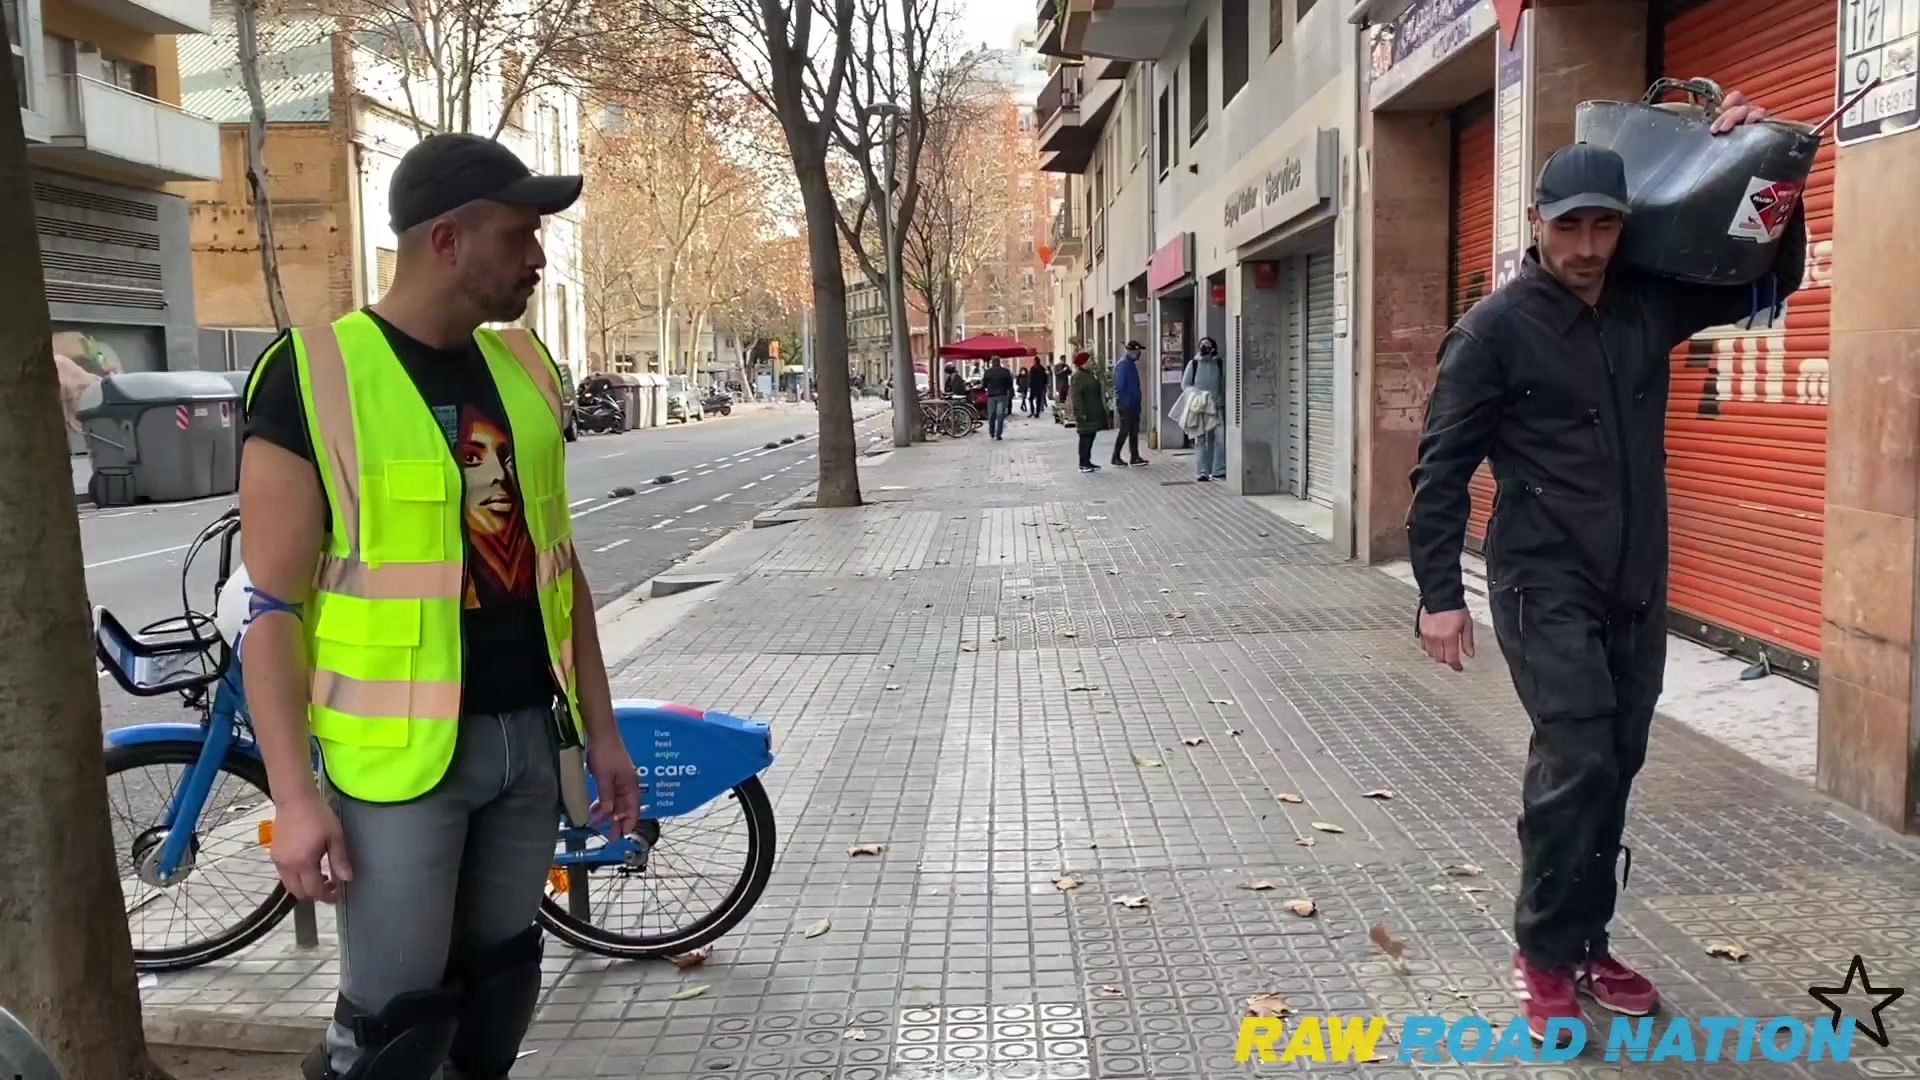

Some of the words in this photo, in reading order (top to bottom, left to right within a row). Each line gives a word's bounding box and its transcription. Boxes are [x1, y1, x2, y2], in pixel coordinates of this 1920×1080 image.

[1265, 157, 1301, 206] Service
[654, 729, 670, 737] live
[655, 740, 672, 748] feel
[655, 751, 680, 760] enjoy
[656, 790, 675, 798] love
